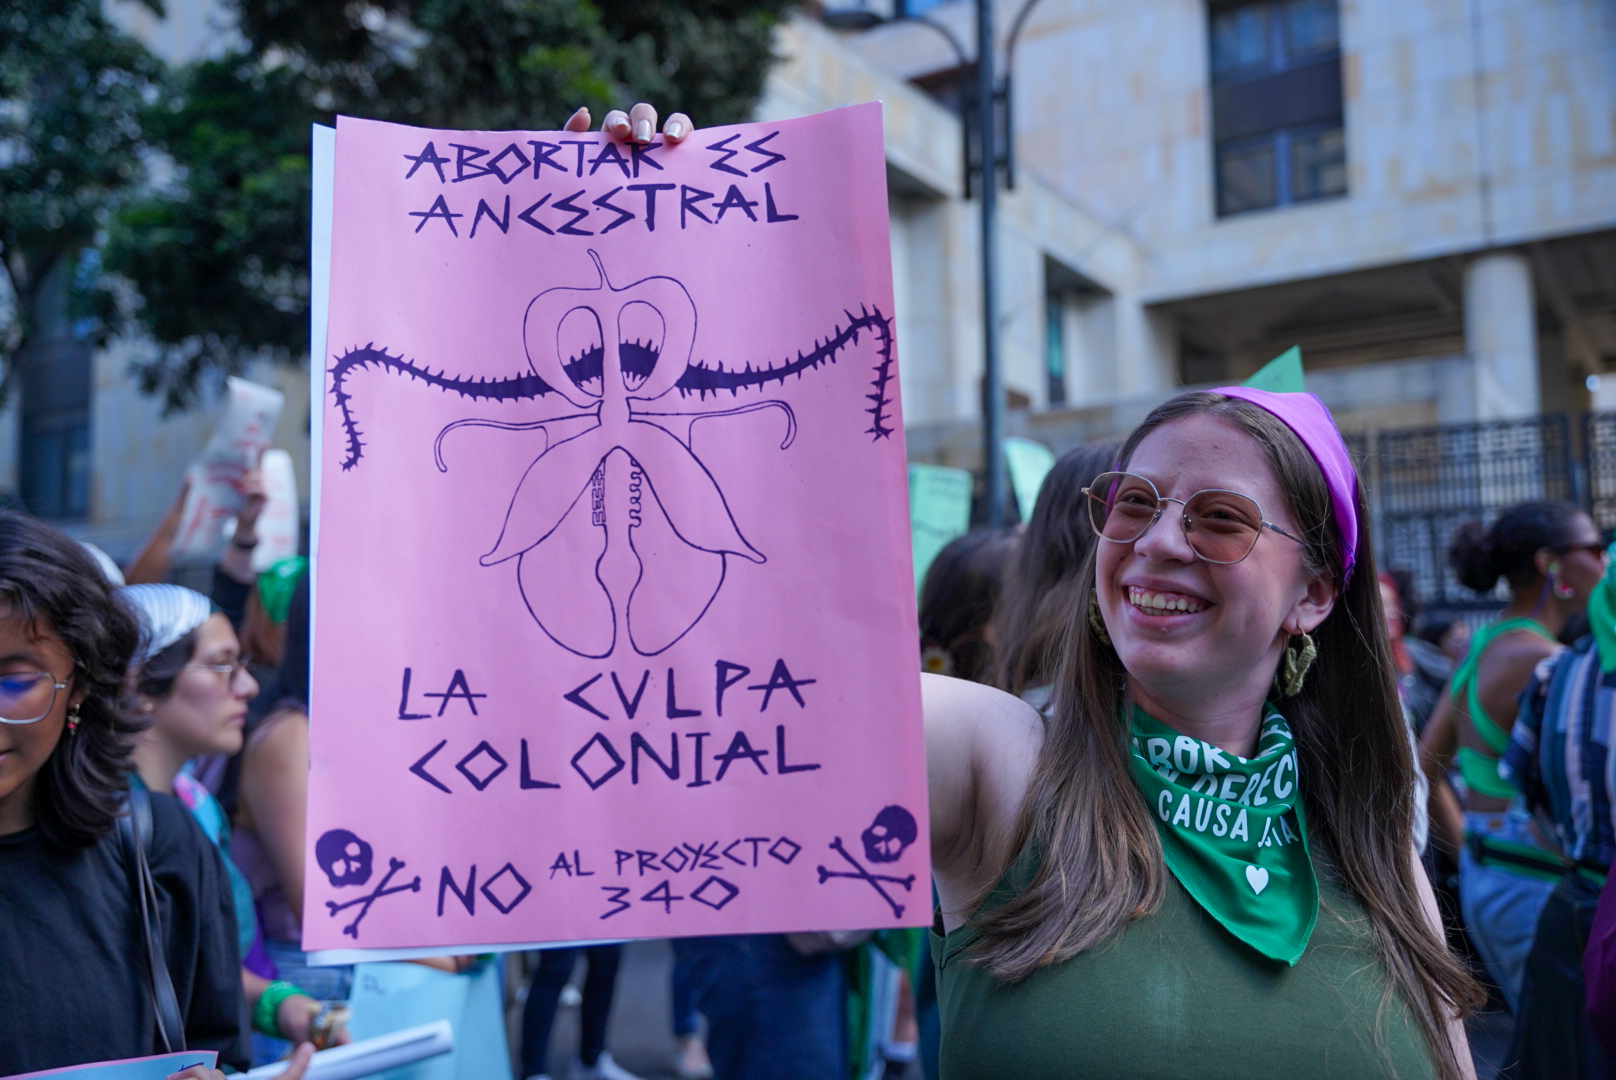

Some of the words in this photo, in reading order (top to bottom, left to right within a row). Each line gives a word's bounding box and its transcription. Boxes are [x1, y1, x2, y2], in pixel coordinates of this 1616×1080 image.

[404, 140, 664, 184] ABORTAR
[706, 131, 787, 177] ES
[408, 182, 800, 238] ANCESTRAL
[398, 667, 487, 720] LA
[408, 725, 822, 794] COLONIAL
[1158, 789, 1249, 842] CAUSA
[437, 863, 533, 916] NO
[549, 850, 595, 878] AL
[614, 836, 802, 877] PROYECTO
[600, 876, 740, 919] 340
